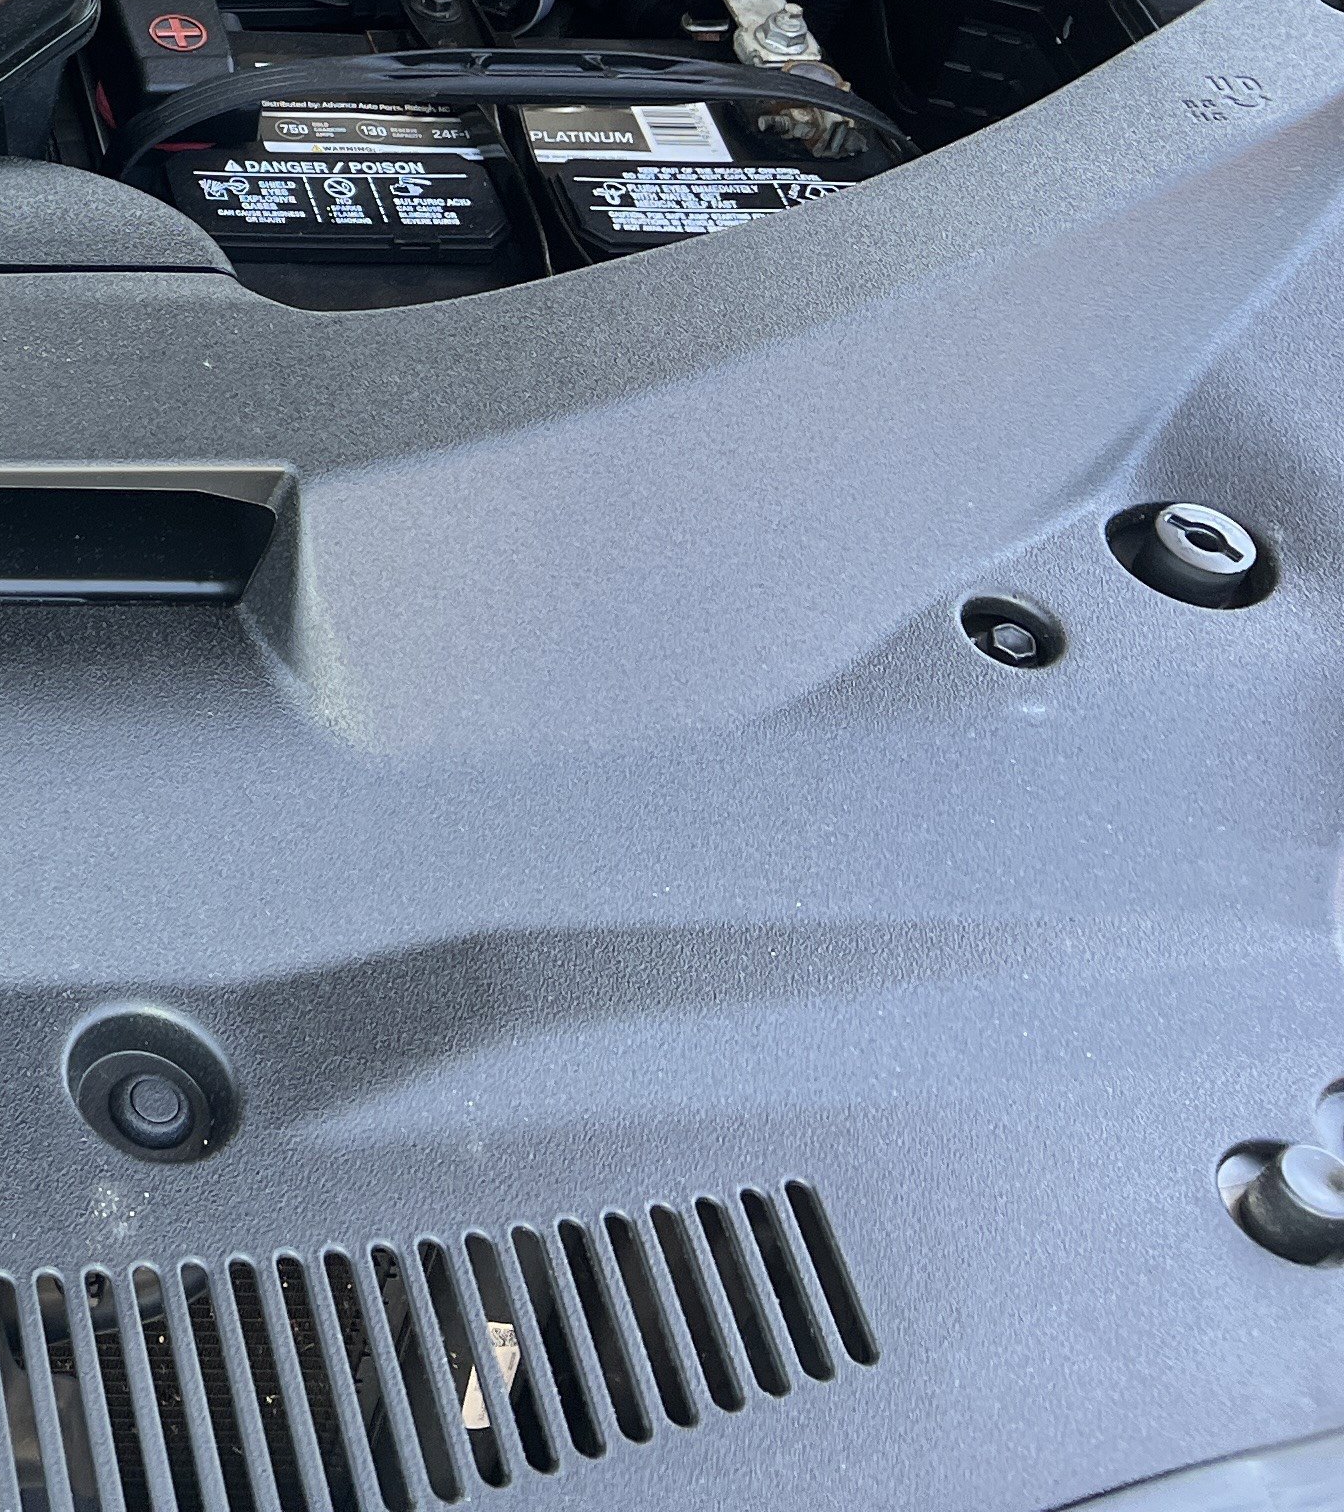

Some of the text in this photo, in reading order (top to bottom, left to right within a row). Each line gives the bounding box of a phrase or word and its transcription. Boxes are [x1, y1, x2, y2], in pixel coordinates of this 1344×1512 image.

[279, 124, 309, 135] 750
[360, 125, 388, 137] 130
[530, 130, 635, 144] PLATINUM
[244, 160, 330, 174] DANGER
[348, 161, 427, 175] POISON
[392, 198, 446, 207] SULFURIC
